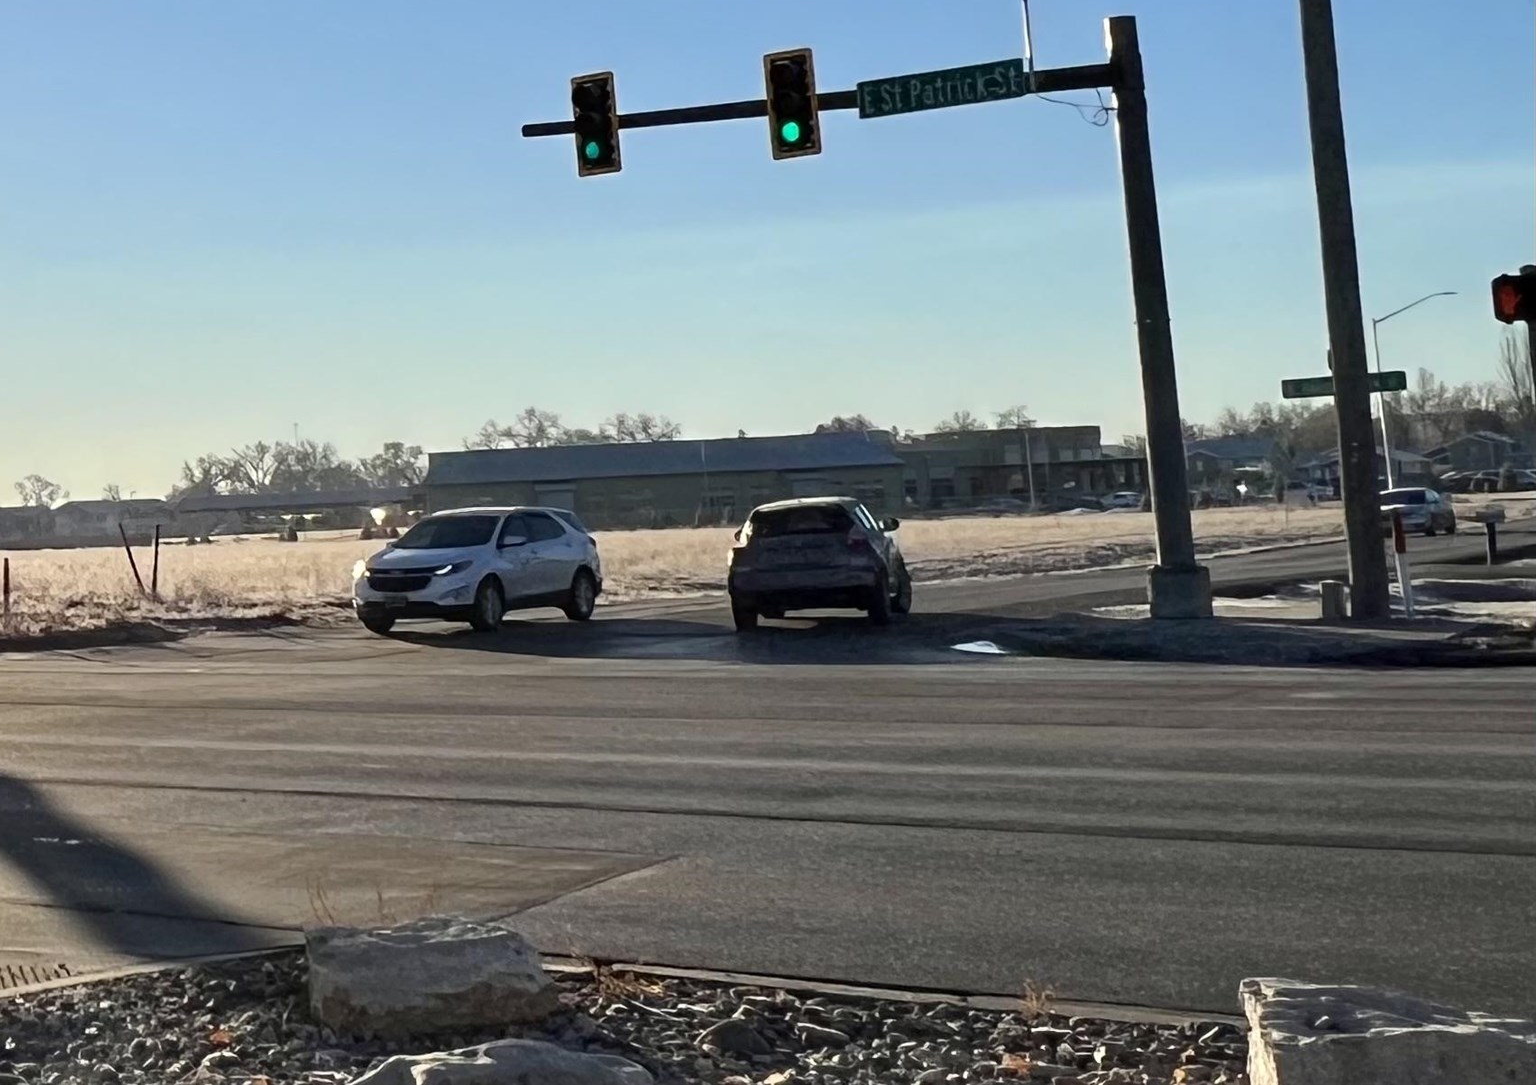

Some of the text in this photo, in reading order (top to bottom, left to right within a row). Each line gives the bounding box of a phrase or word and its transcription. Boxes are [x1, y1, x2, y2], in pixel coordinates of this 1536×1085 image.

[863, 66, 1021, 114] E St Patrick St
